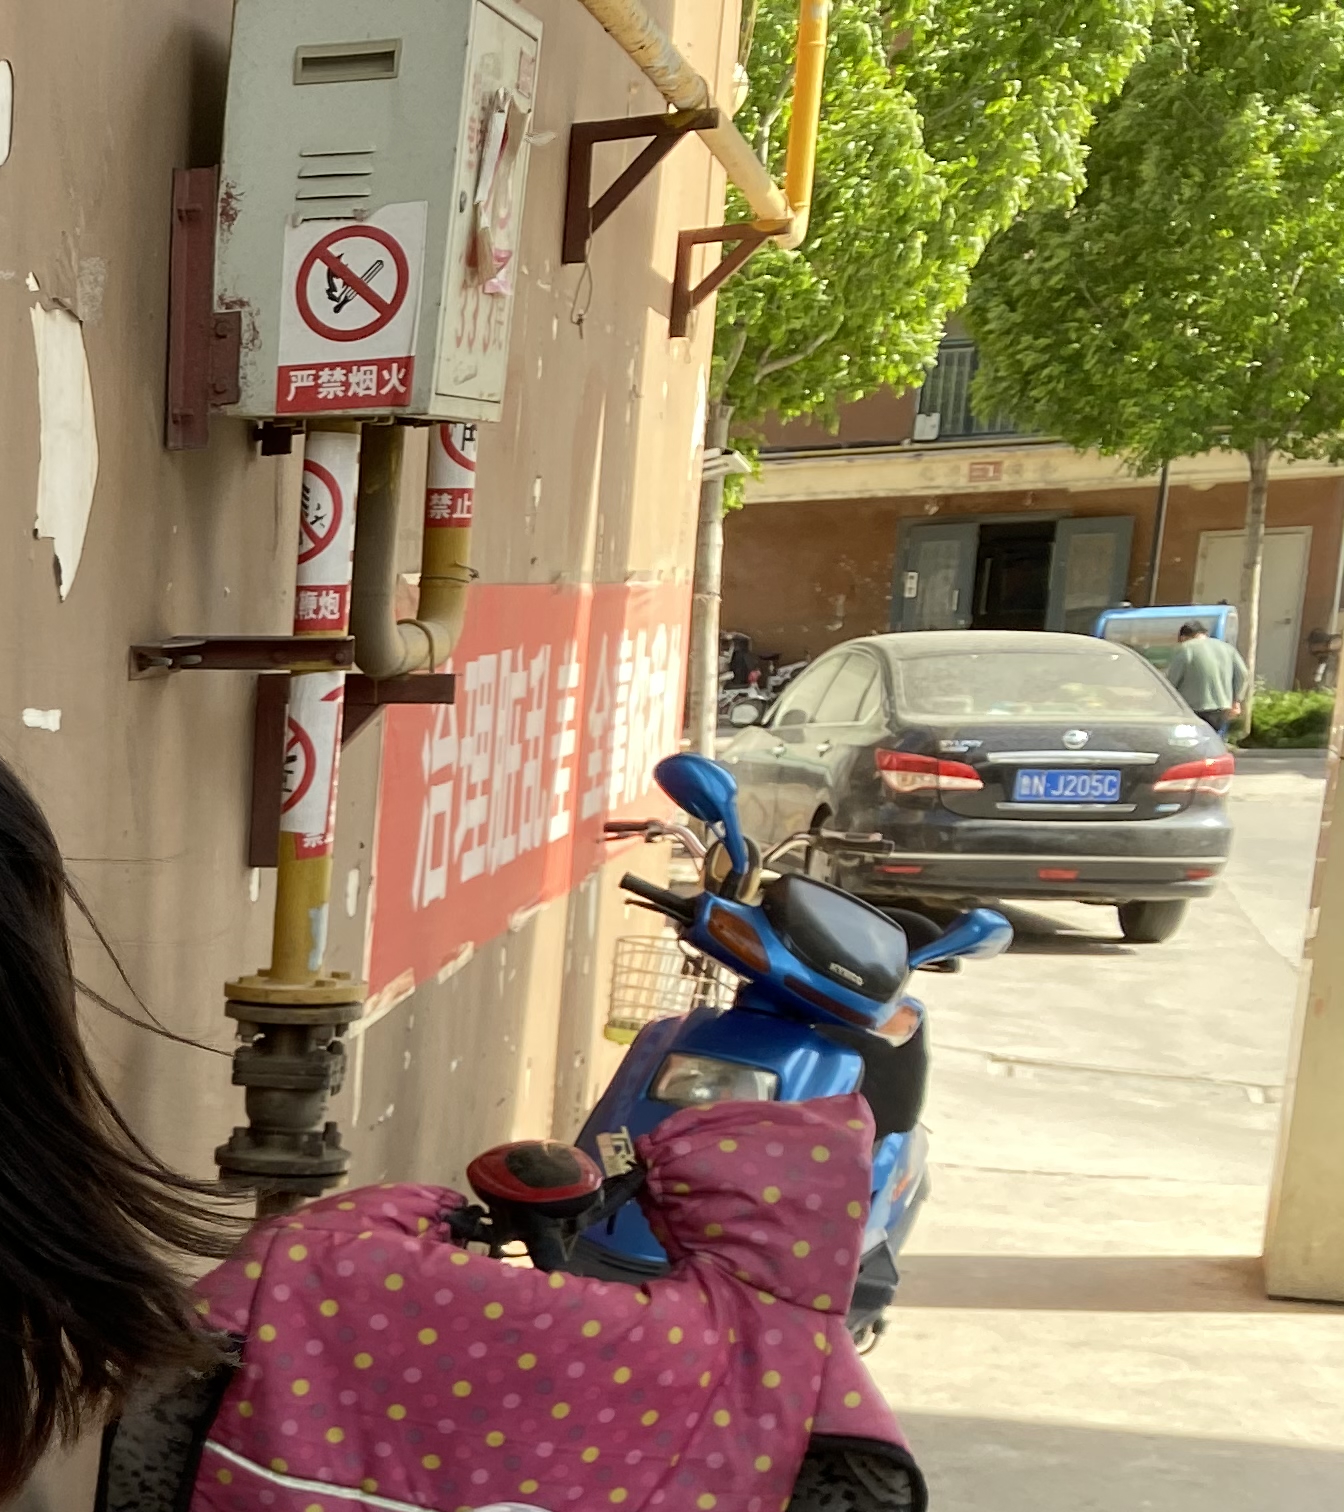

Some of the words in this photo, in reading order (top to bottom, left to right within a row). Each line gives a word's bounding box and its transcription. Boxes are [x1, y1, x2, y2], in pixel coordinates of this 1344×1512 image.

[286, 363, 407, 401] 严禁烟火
[429, 492, 473, 519] 禁止
